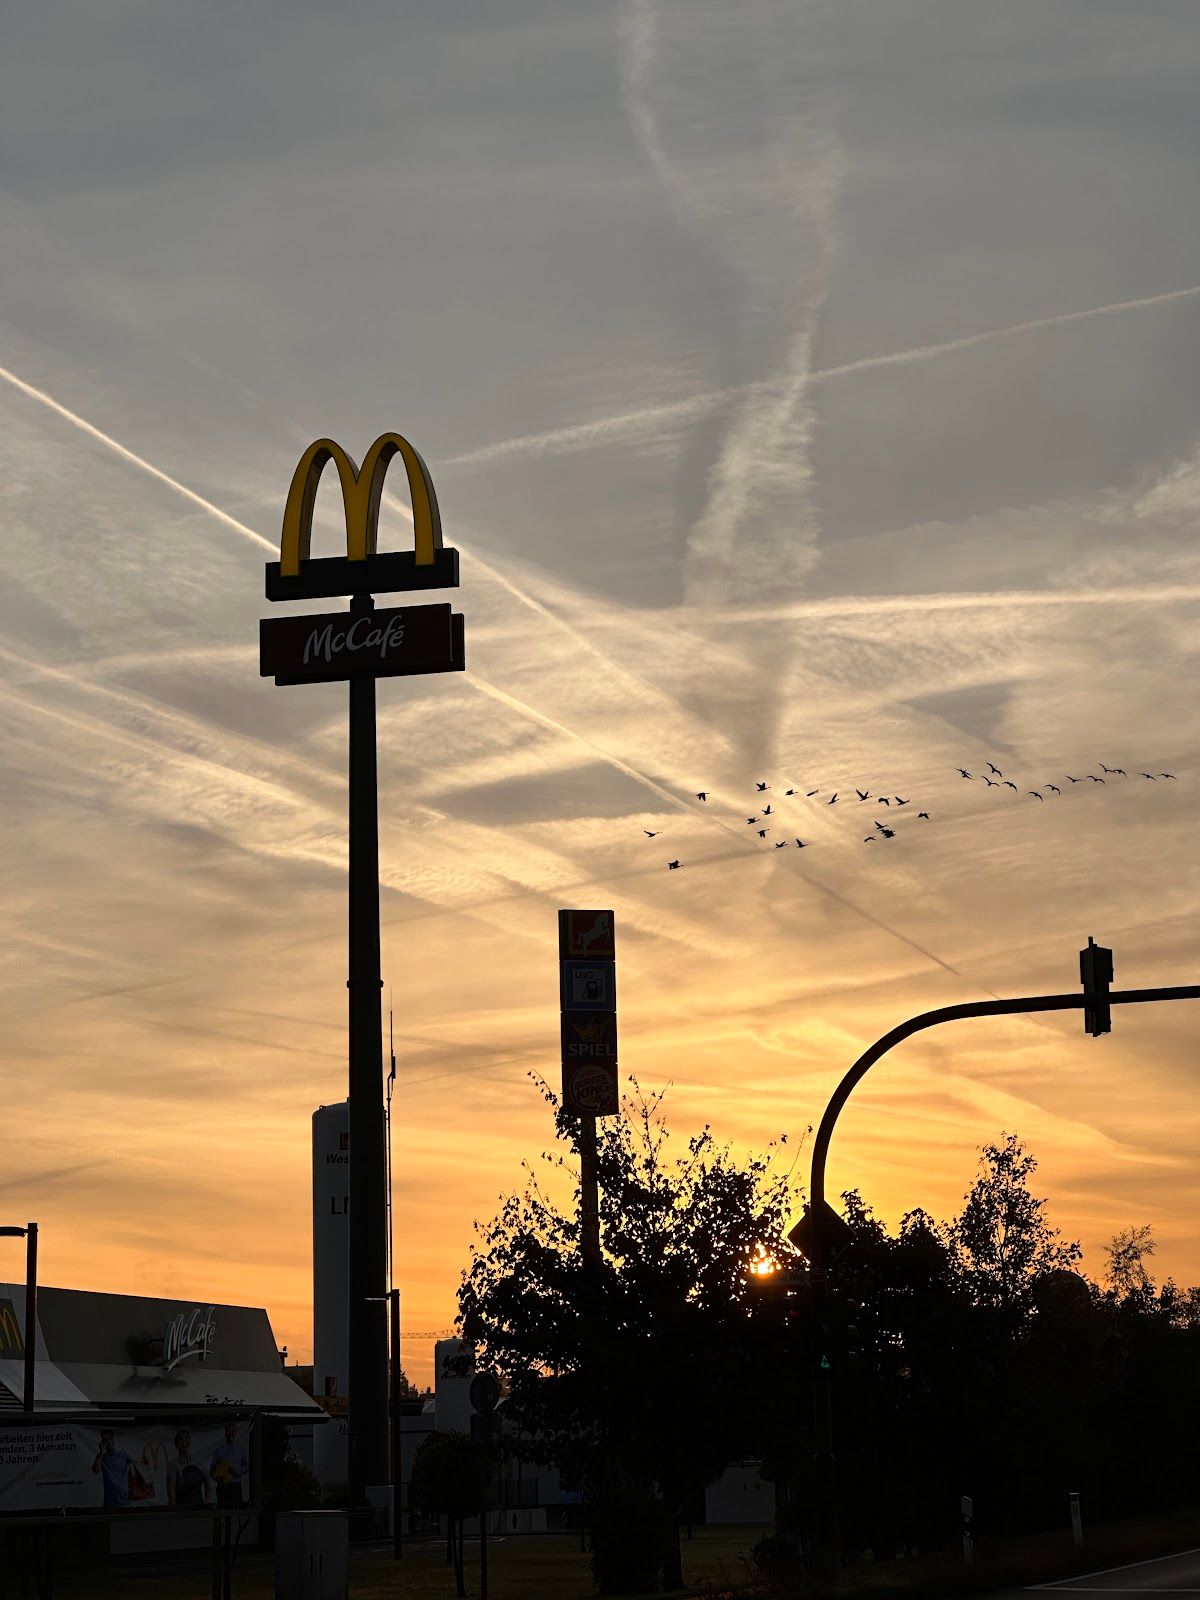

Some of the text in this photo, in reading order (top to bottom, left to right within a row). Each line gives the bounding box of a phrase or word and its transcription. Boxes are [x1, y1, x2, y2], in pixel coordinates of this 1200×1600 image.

[303, 615, 405, 664] McCafé
[575, 970, 593, 979] LNG
[567, 1043, 616, 1057] SPIEL
[164, 1306, 216, 1361] McCafé
[36, 1432, 54, 1442] hier
[55, 1431, 72, 1441] seit
[28, 1444, 35, 1453] 3
[36, 1443, 76, 1452] Monaten
[6, 1454, 40, 1464] Jahren
